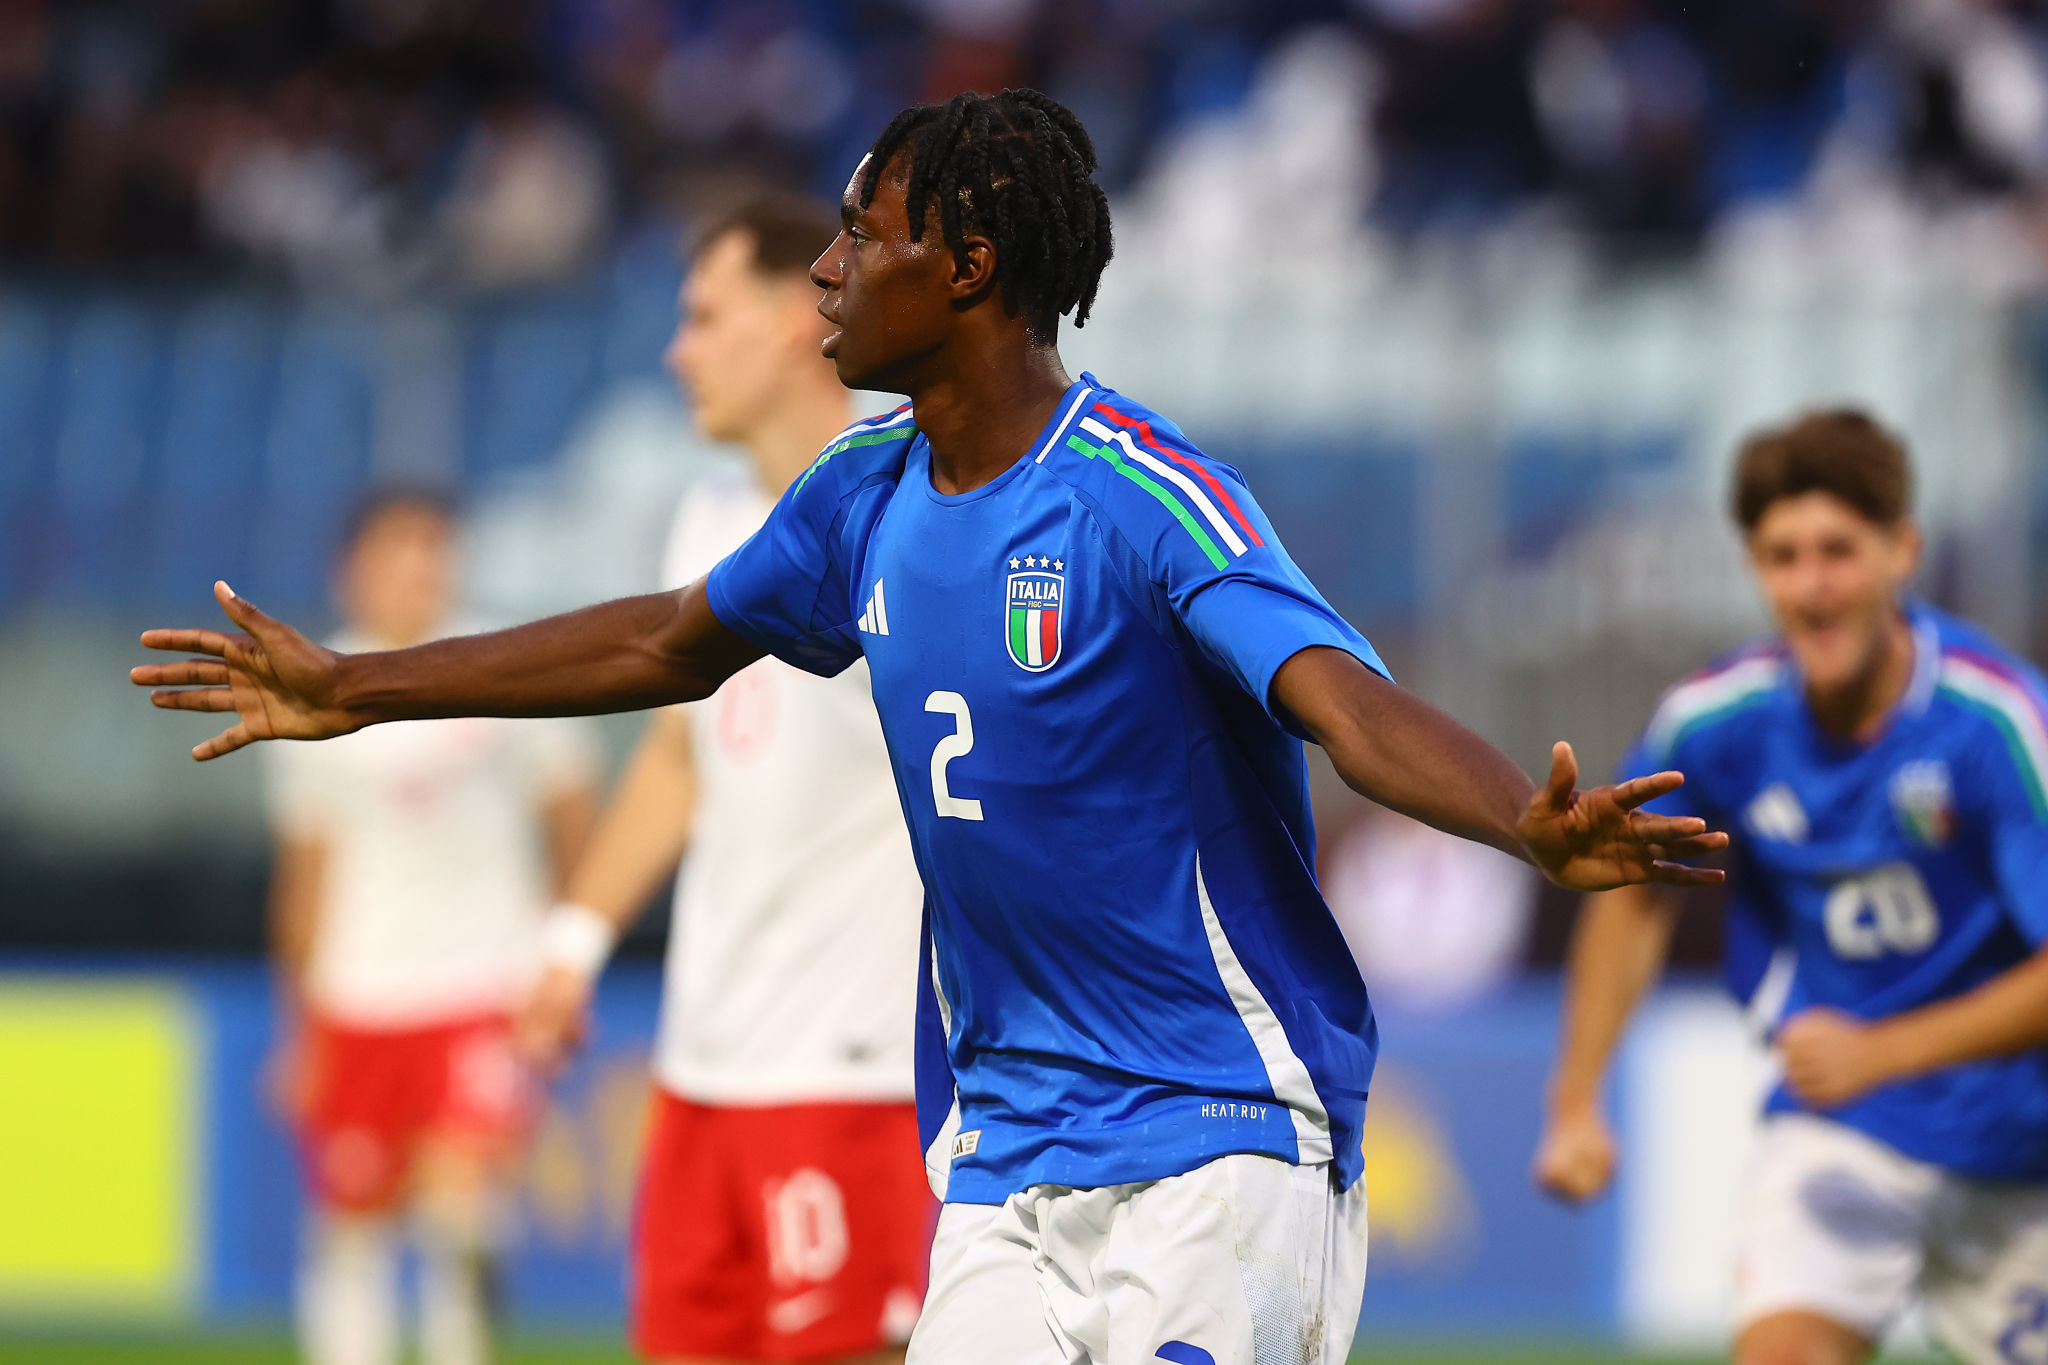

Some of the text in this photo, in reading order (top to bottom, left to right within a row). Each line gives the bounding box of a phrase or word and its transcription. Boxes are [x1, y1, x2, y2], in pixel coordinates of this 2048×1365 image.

[1011, 580, 1059, 601] ITALIA
[1027, 600, 1042, 608] FIGC
[924, 690, 984, 821] 2
[1824, 864, 1938, 959] 20
[1201, 1103, 1267, 1120] HEAT.RDY
[763, 1168, 850, 1284] 10
